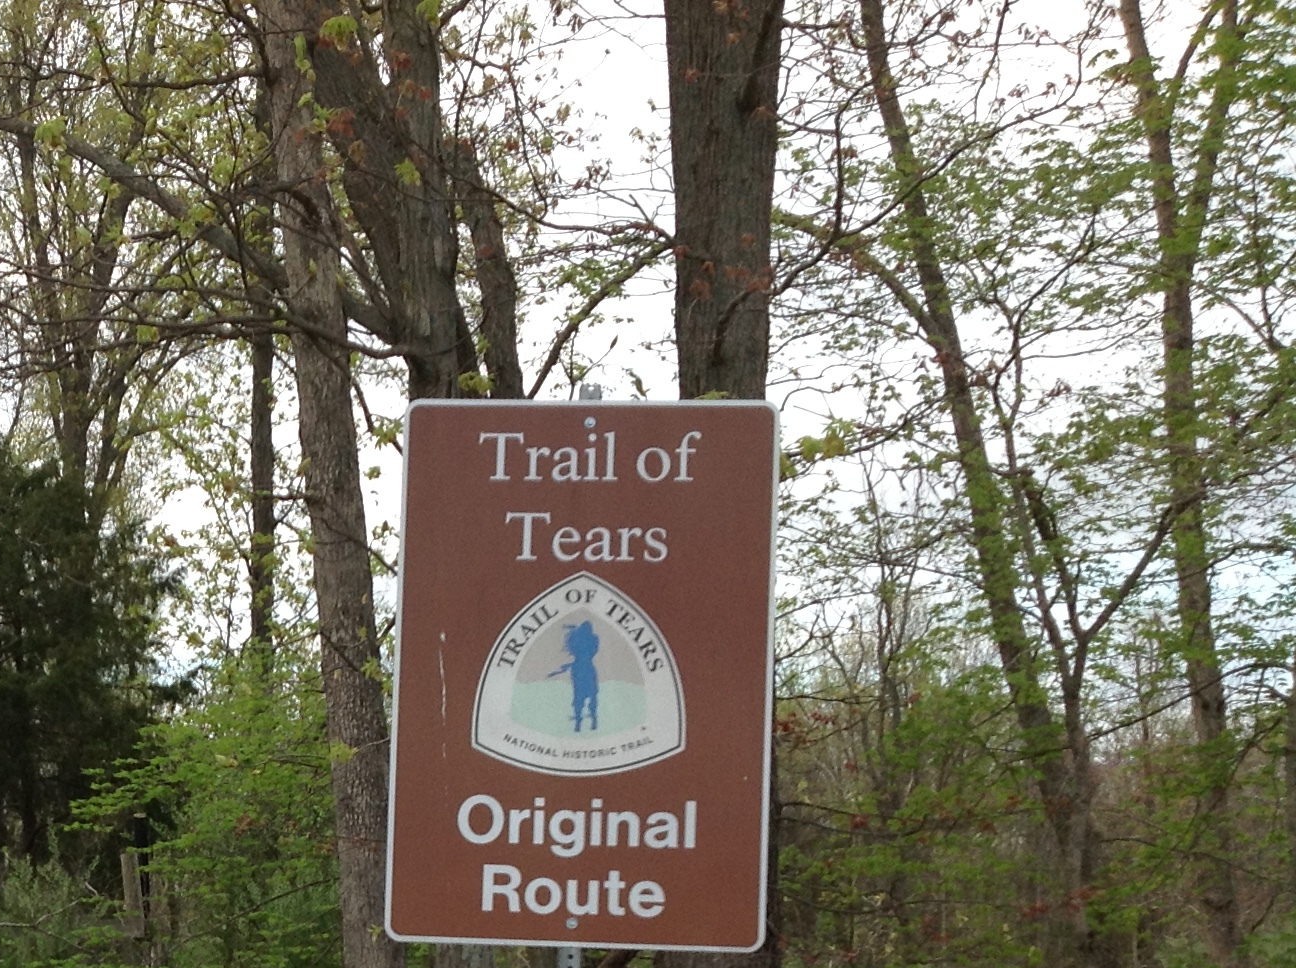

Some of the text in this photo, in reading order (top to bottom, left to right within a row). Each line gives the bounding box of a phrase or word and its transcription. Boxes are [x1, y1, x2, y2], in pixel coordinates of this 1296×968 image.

[479, 430, 703, 483] Trail of
[505, 511, 669, 563] Tears
[496, 588, 664, 673] TRAIL OF TEARS
[502, 733, 654, 760] NATIONAL HISTORIC TRAIL
[456, 793, 698, 858] Original
[480, 863, 666, 918] Route
